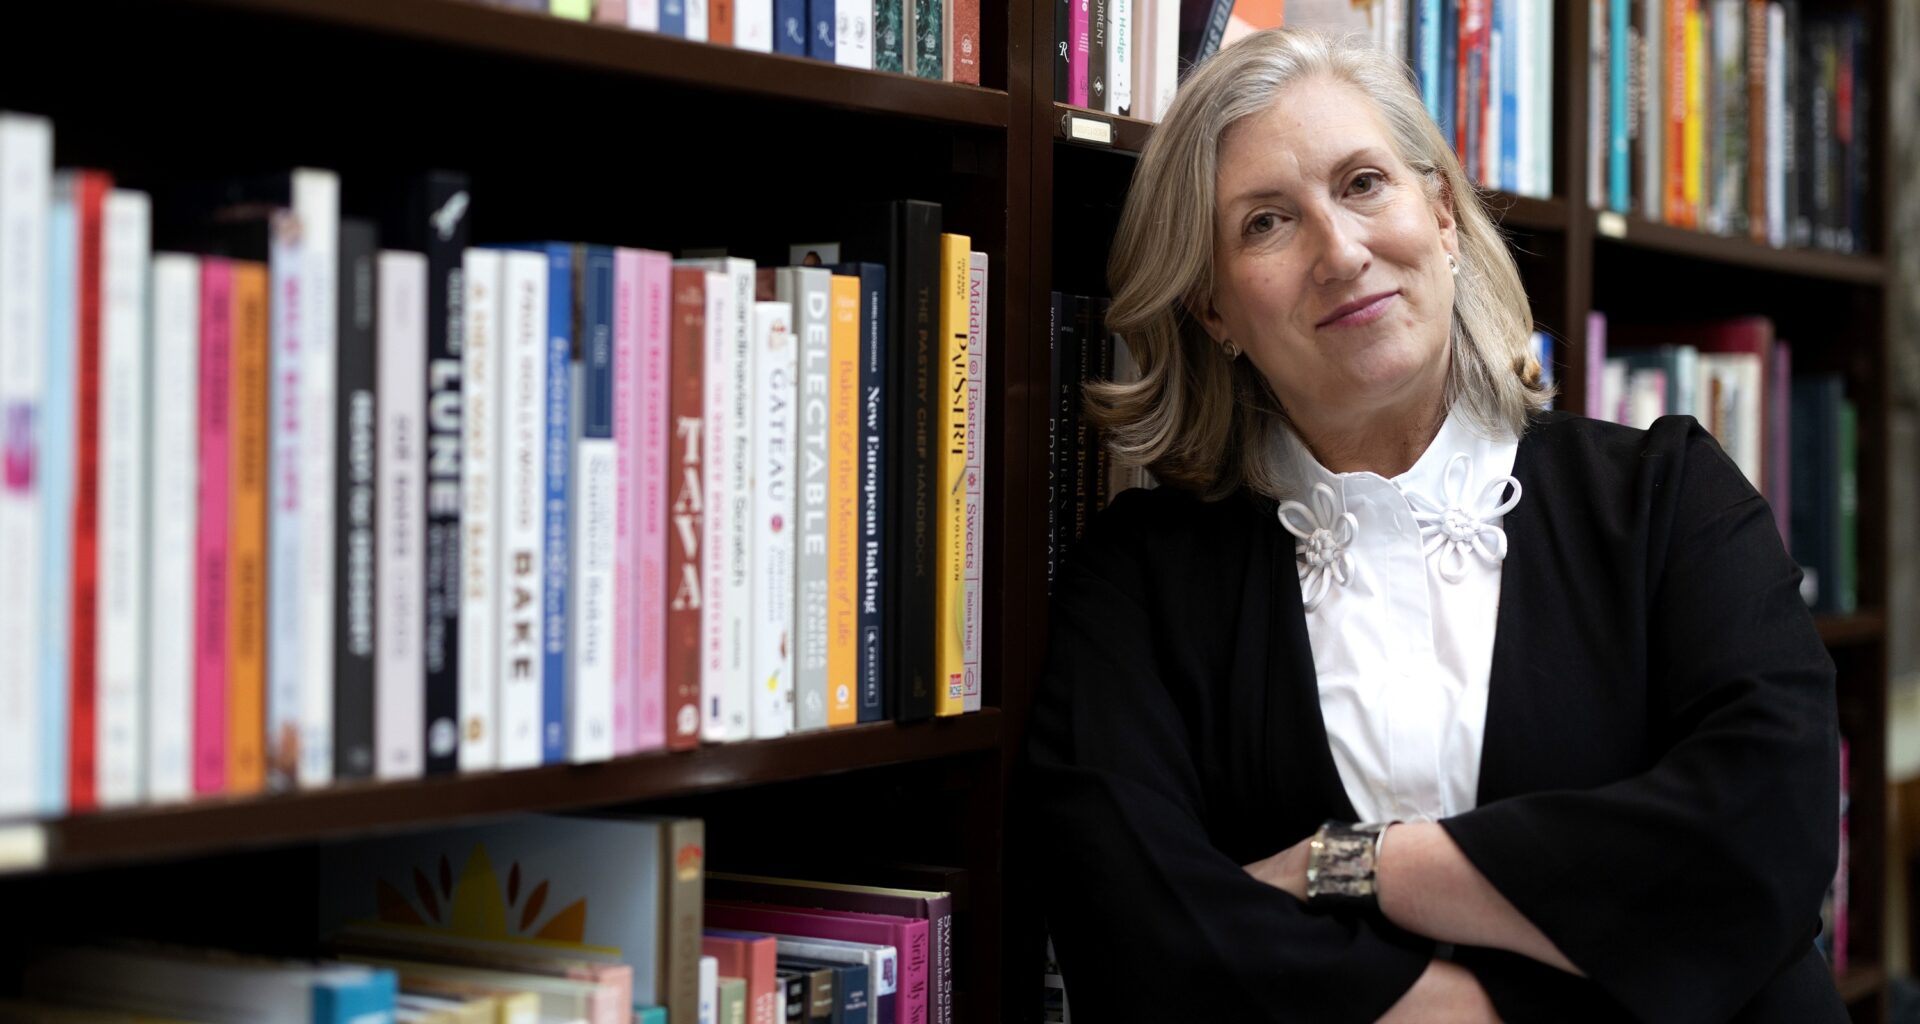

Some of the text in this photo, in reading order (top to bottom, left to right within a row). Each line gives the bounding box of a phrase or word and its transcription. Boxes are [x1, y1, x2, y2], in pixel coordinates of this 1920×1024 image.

[1059, 41, 1070, 64] R
[1117, 17, 1127, 64] Hodge
[837, 360, 853, 426] Baking
[967, 279, 982, 461] Middle Eastern
[428, 358, 463, 517] LUNE
[732, 274, 751, 587] Scandinavian from Scratch
[804, 291, 827, 557] DELECTABLE
[914, 286, 930, 577] THE PASTRY CHEF HANDBOOK
[671, 416, 705, 610] TAVA
[839, 459, 852, 491] the
[864, 386, 881, 613] New European Baking
[835, 497, 852, 582] Meaning
[953, 498, 961, 582] REVOLUTION
[965, 503, 978, 570] Sweets
[512, 550, 534, 680] BAKE
[807, 580, 817, 671] FLEMING
[816, 580, 827, 668] CLAUDIA
[836, 587, 851, 607] of
[837, 611, 851, 647] Life
[966, 591, 976, 622] Salma
[943, 914, 952, 977] Sweet
[906, 981, 925, 1001] My
